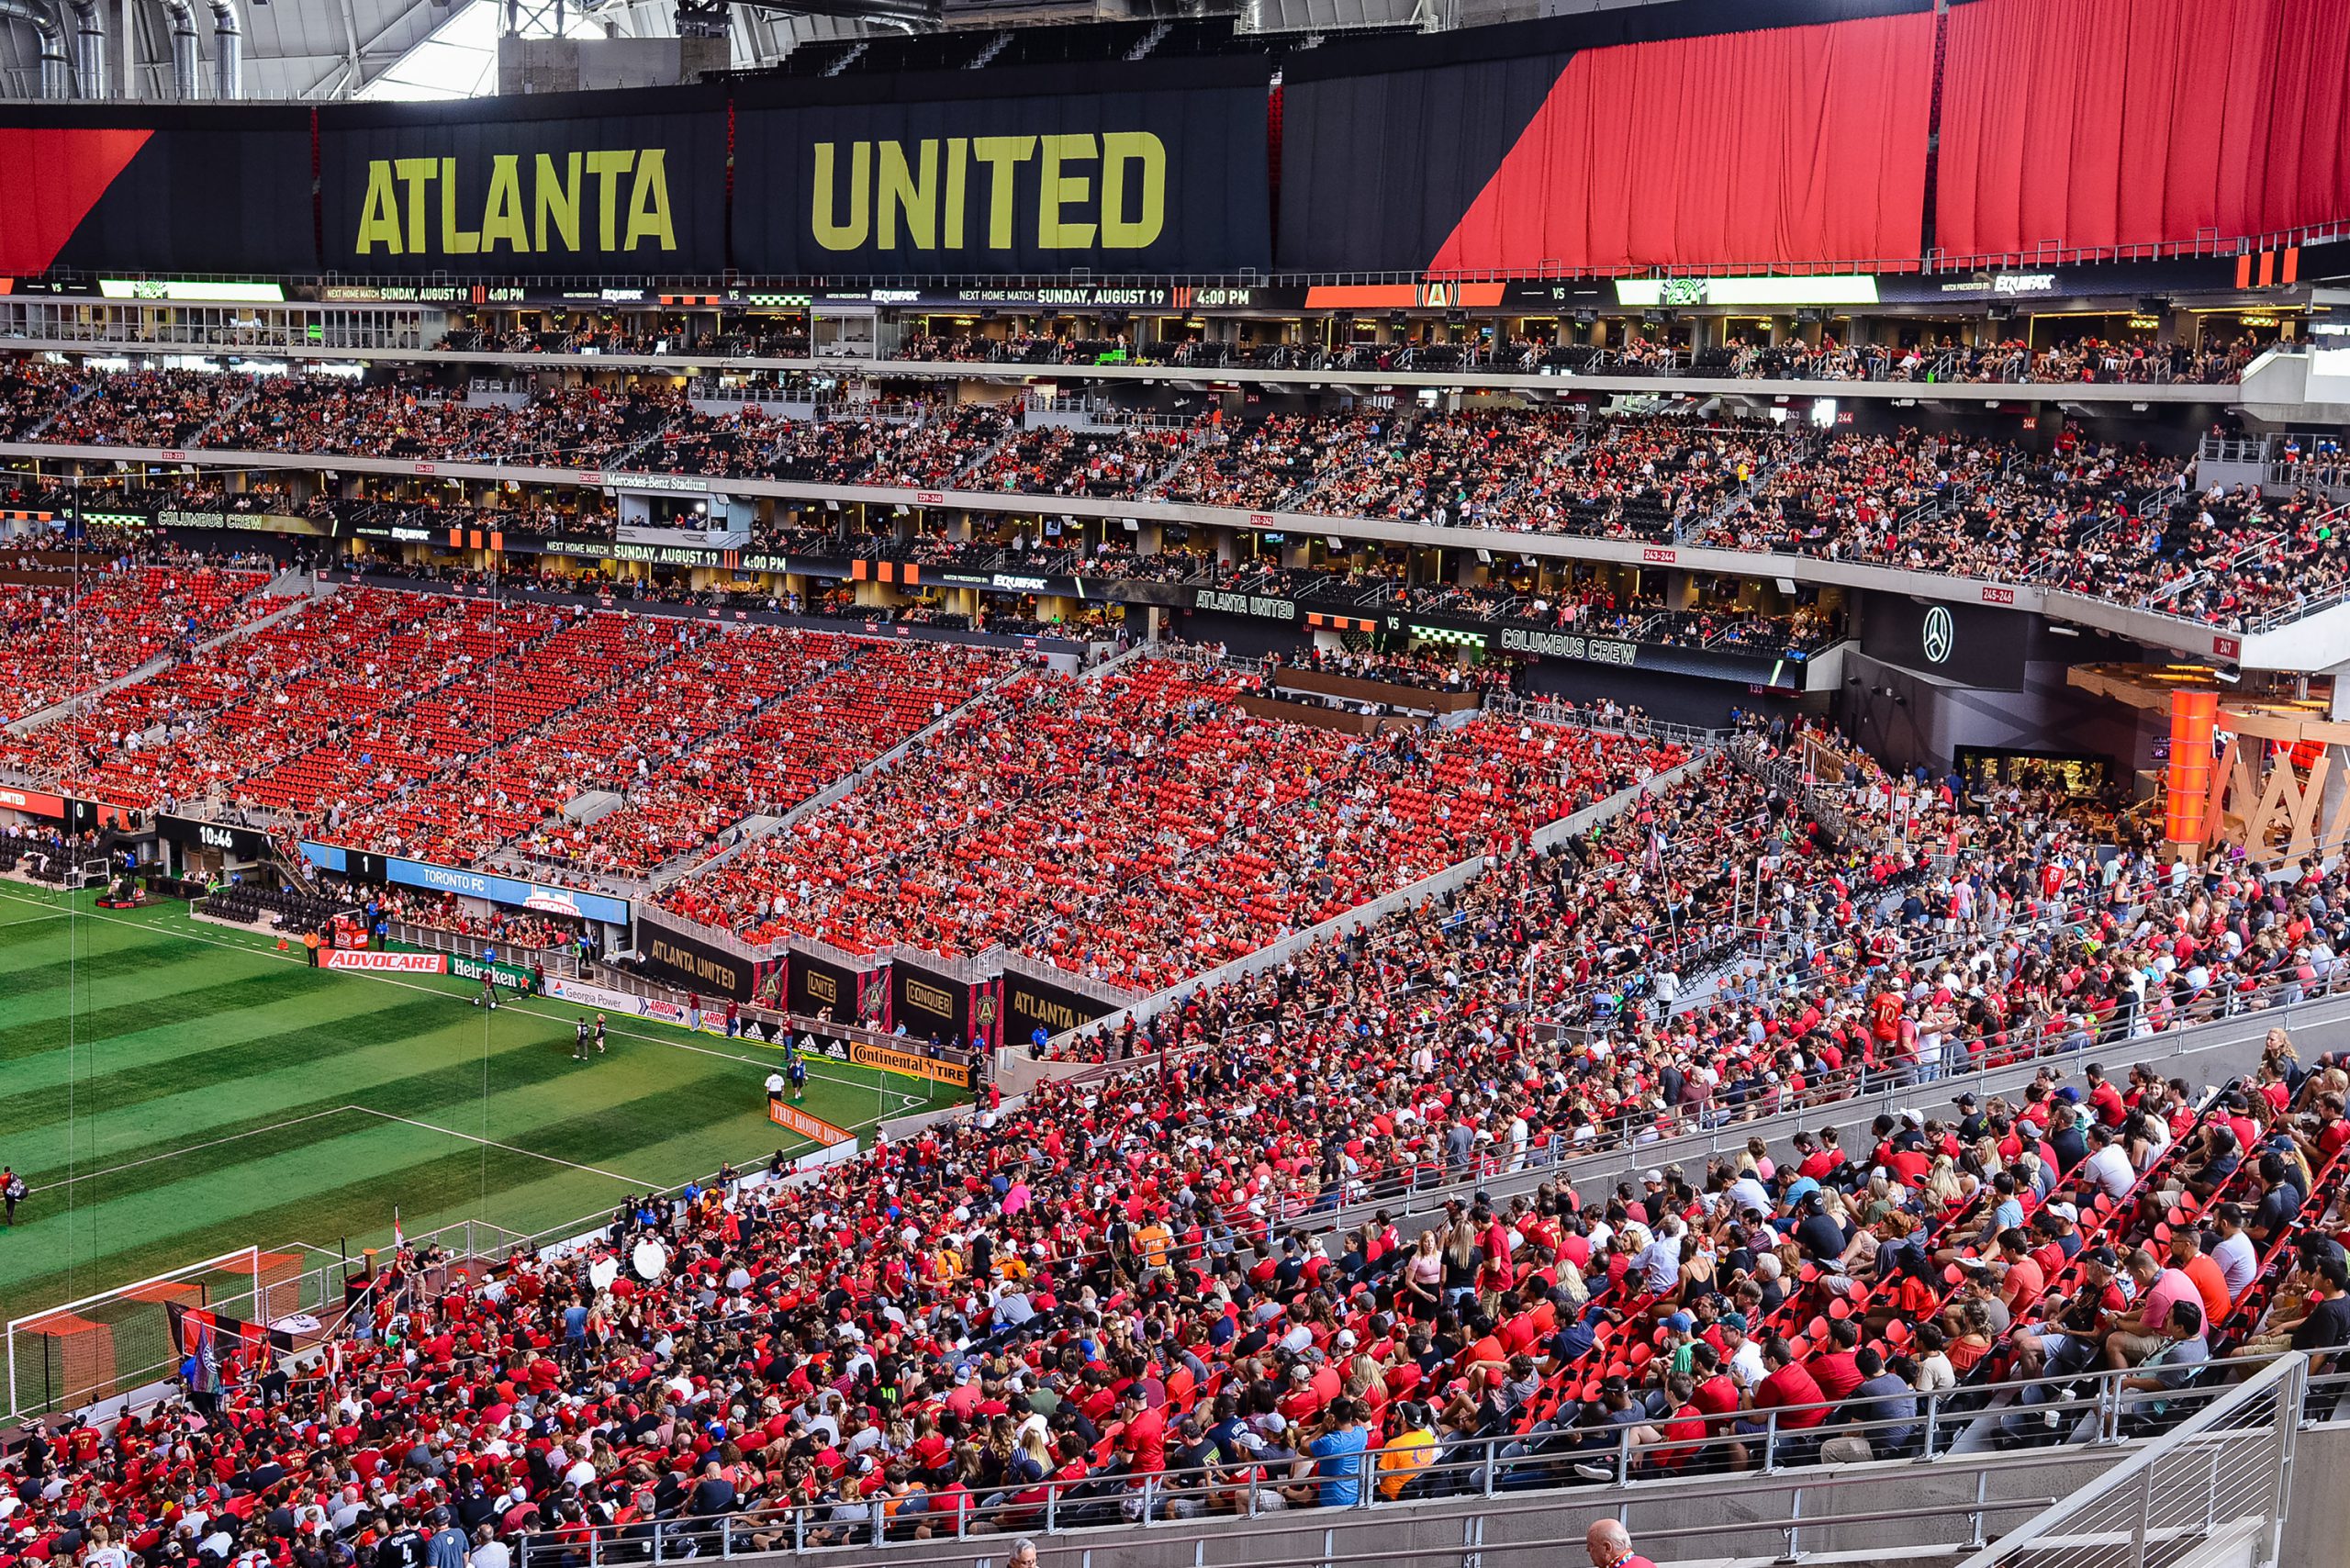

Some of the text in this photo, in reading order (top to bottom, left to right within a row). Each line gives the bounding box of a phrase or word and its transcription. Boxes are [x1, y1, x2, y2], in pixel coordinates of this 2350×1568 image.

[355, 131, 1166, 254] ATLANTA UNITED
[51, 283, 62, 293] VS
[1942, 284, 1956, 292] MATCH
[1957, 283, 1982, 291] PRESENTED
[1994, 274, 2055, 295] EQUIFAX
[327, 287, 524, 302] NEXT HOME MATCH SUNDAY, AUGUST 19 4:00 PM
[601, 288, 643, 302] EQUIFAX
[728, 290, 739, 301] VS
[871, 290, 919, 303] EQUIFAX
[959, 289, 1249, 306] NEXT HOME MATCH SUNDAY, AUGUST 19 4:00 PM
[1551, 287, 1565, 300] VS
[1575, 403, 1586, 412] 242
[1838, 413, 1852, 421] 244
[2022, 419, 2035, 428] 244
[607, 474, 707, 491] Mercedes-Benz Stadium
[918, 494, 942, 503] 239-240
[62, 508, 73, 520] VS
[158, 510, 263, 530] COLUMBUS CREW
[1250, 515, 1273, 526] 241-242
[391, 527, 431, 541] EQUIFAX
[546, 541, 787, 571] NEXT HOME MATCH SUNDAY, AUGUST 19 4:00 PM
[1645, 551, 1674, 563] 243-244
[992, 574, 1047, 589] EQUIFAX
[1983, 588, 2012, 602] 245-246
[1196, 589, 1294, 620] ATLANTA UNITED
[1387, 616, 1400, 631] VS
[1501, 628, 1637, 665] COLUMBUS CREW
[2220, 641, 2232, 655] 247
[1750, 684, 1763, 694] 133
[76, 802, 84, 819] 0
[199, 825, 233, 848] 10:46
[363, 856, 368, 872] 1
[423, 868, 485, 892] TORONTO FC
[330, 951, 438, 972] ADVOCARE
[651, 939, 695, 971] ATLANTA
[697, 957, 735, 990] UNITED
[810, 974, 835, 998] UNITE
[565, 986, 621, 1010] Georgia Power
[908, 984, 951, 1014] CONQUER
[649, 1000, 677, 1015] ARROW
[1013, 991, 1074, 1029] ATLANTA
[646, 1011, 677, 1022] EXTERMINATORS
[704, 1012, 728, 1026] ARRO
[744, 1032, 765, 1042] adidas
[798, 1044, 819, 1053] adidas
[825, 1049, 846, 1060] adidas
[854, 1045, 965, 1081] Continental TIRE
[773, 1103, 793, 1126] THE
[794, 1113, 822, 1138] HOME
[391, 1534, 418, 1546] Corona
[402, 1543, 412, 1562] 4
